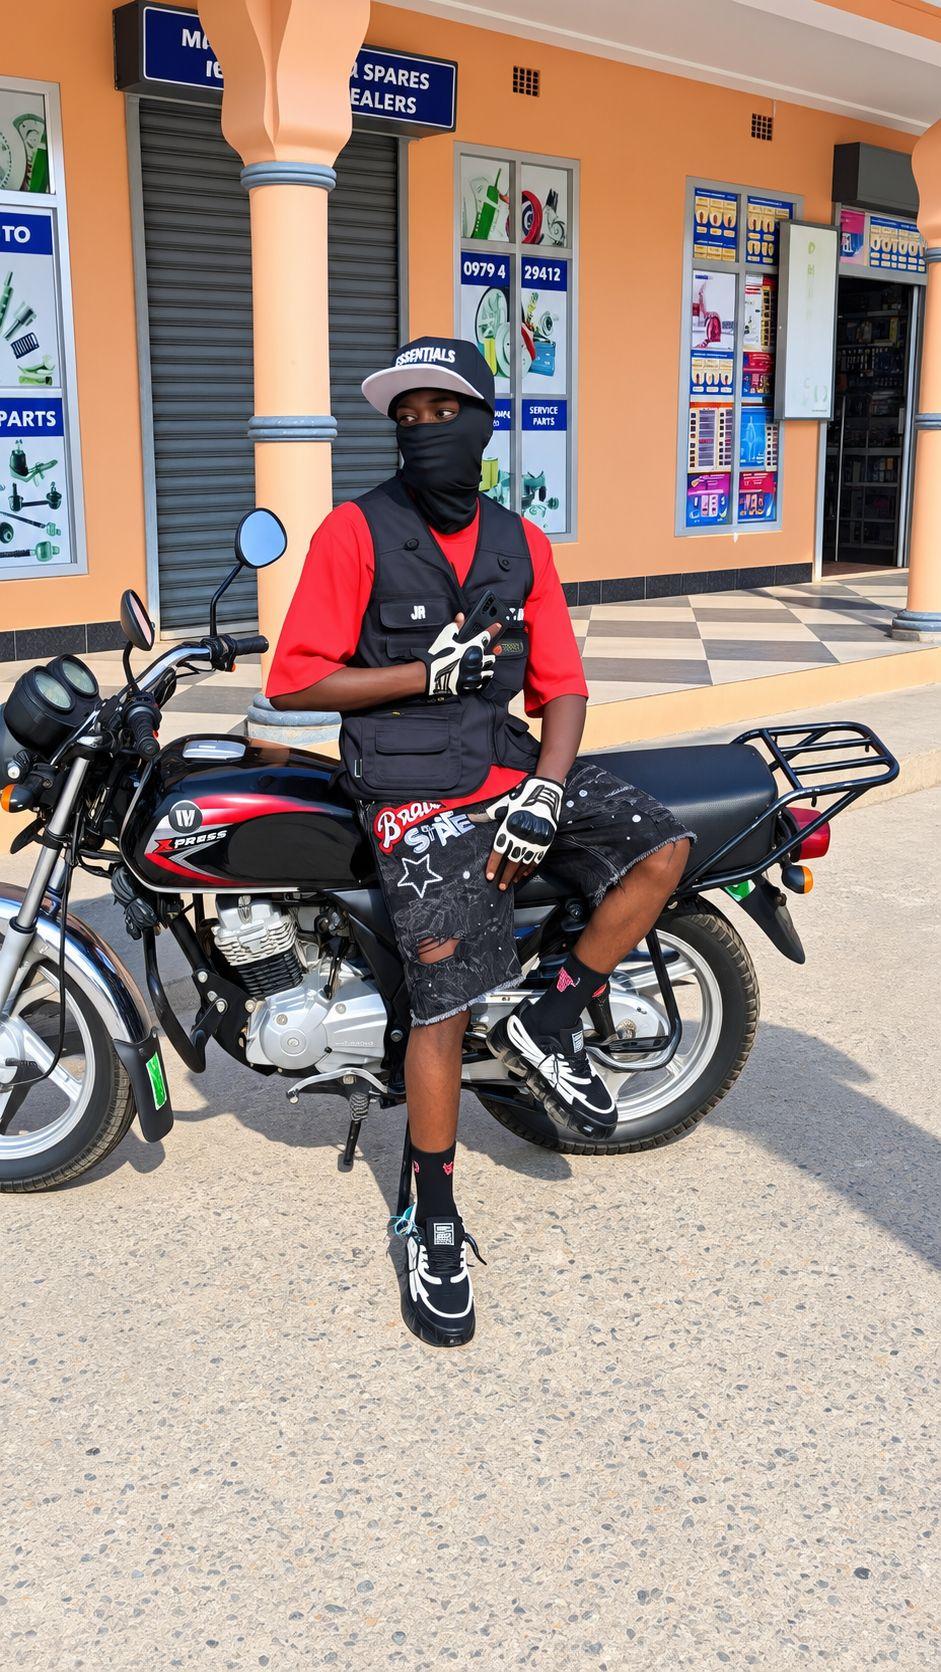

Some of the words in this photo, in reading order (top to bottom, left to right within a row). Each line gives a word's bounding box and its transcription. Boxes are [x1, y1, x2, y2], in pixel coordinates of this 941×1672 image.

[363, 63, 430, 90] SPARES
[350, 87, 417, 114] EALERS
[1, 225, 31, 244] TO
[463, 260, 496, 278] 0979
[497, 264, 506, 279] 4
[524, 265, 561, 281] 29412
[395, 346, 456, 366] ESSENTIALS
[529, 406, 559, 415] SERVICE
[532, 417, 555, 426] PARTS
[410, 605, 426, 620] JR
